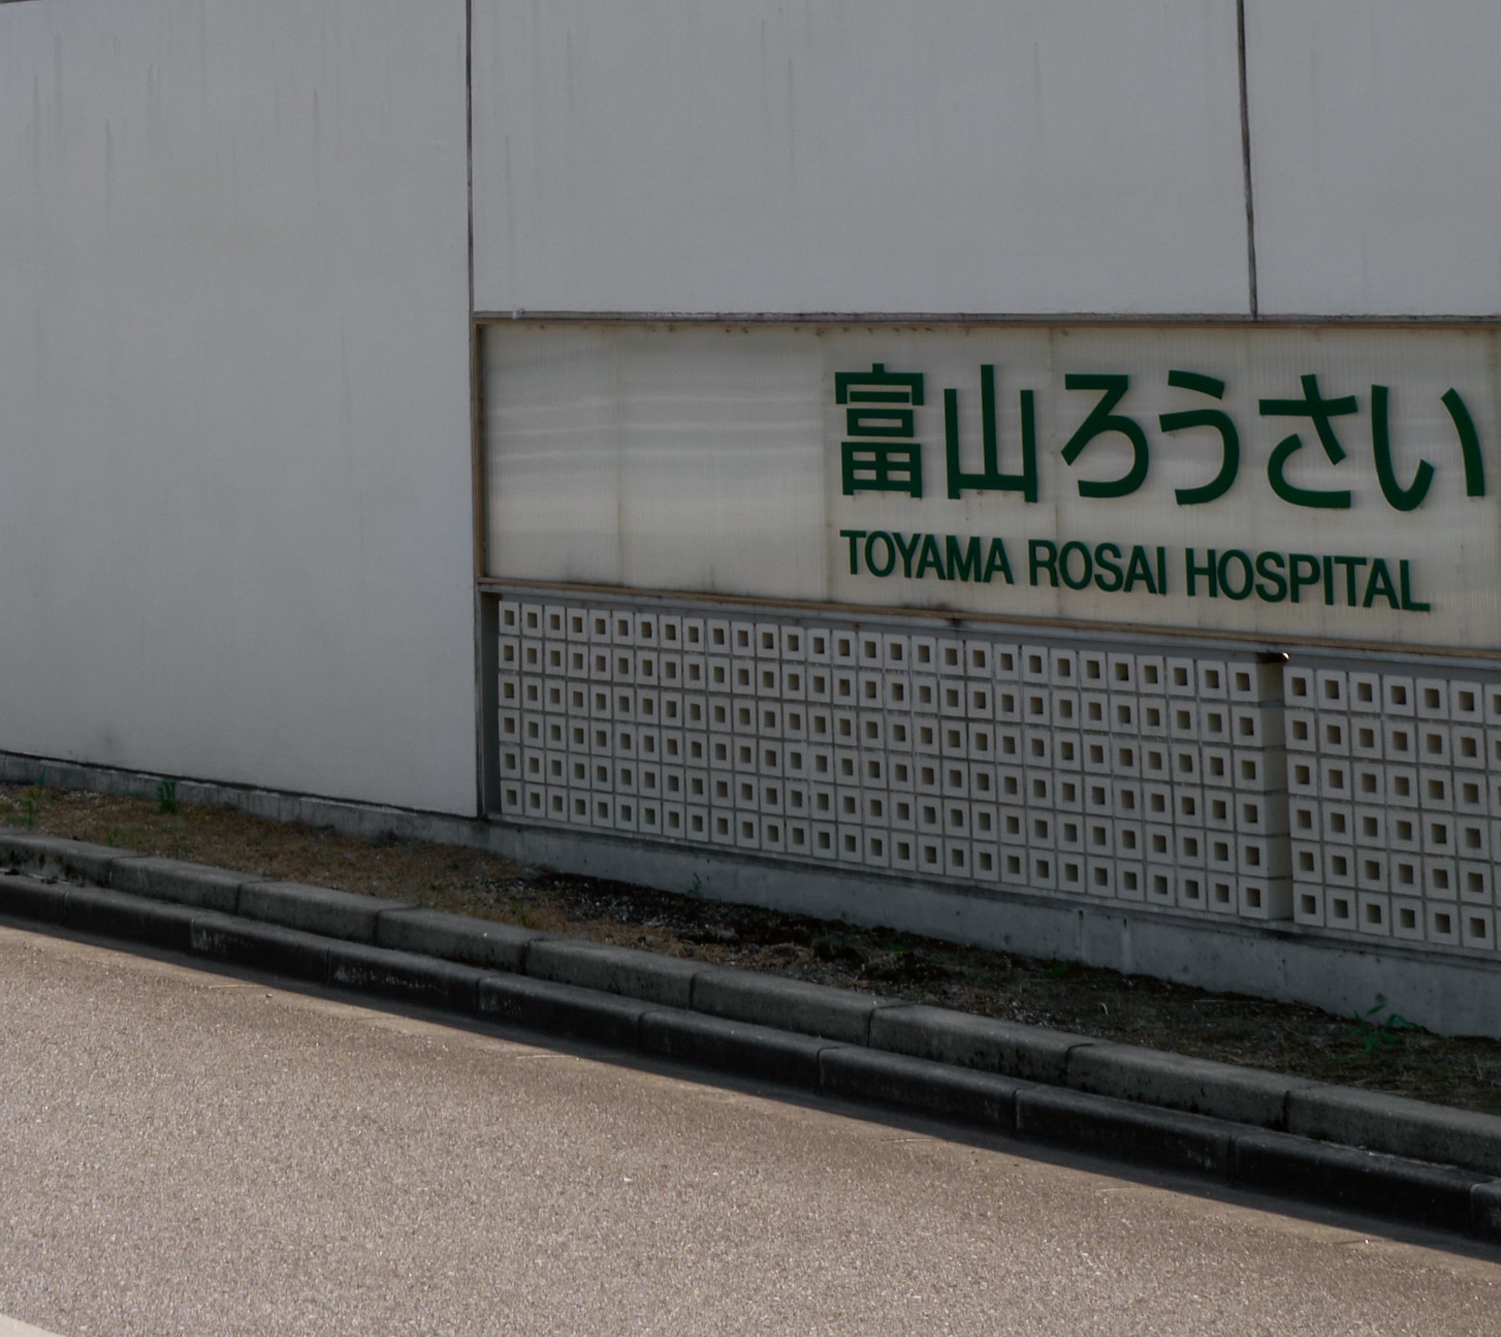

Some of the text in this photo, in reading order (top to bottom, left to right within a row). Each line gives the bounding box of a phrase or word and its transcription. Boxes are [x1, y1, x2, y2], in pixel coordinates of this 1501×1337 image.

[840, 529, 1432, 612] TOYAMA ROSAI HOSPITAL
